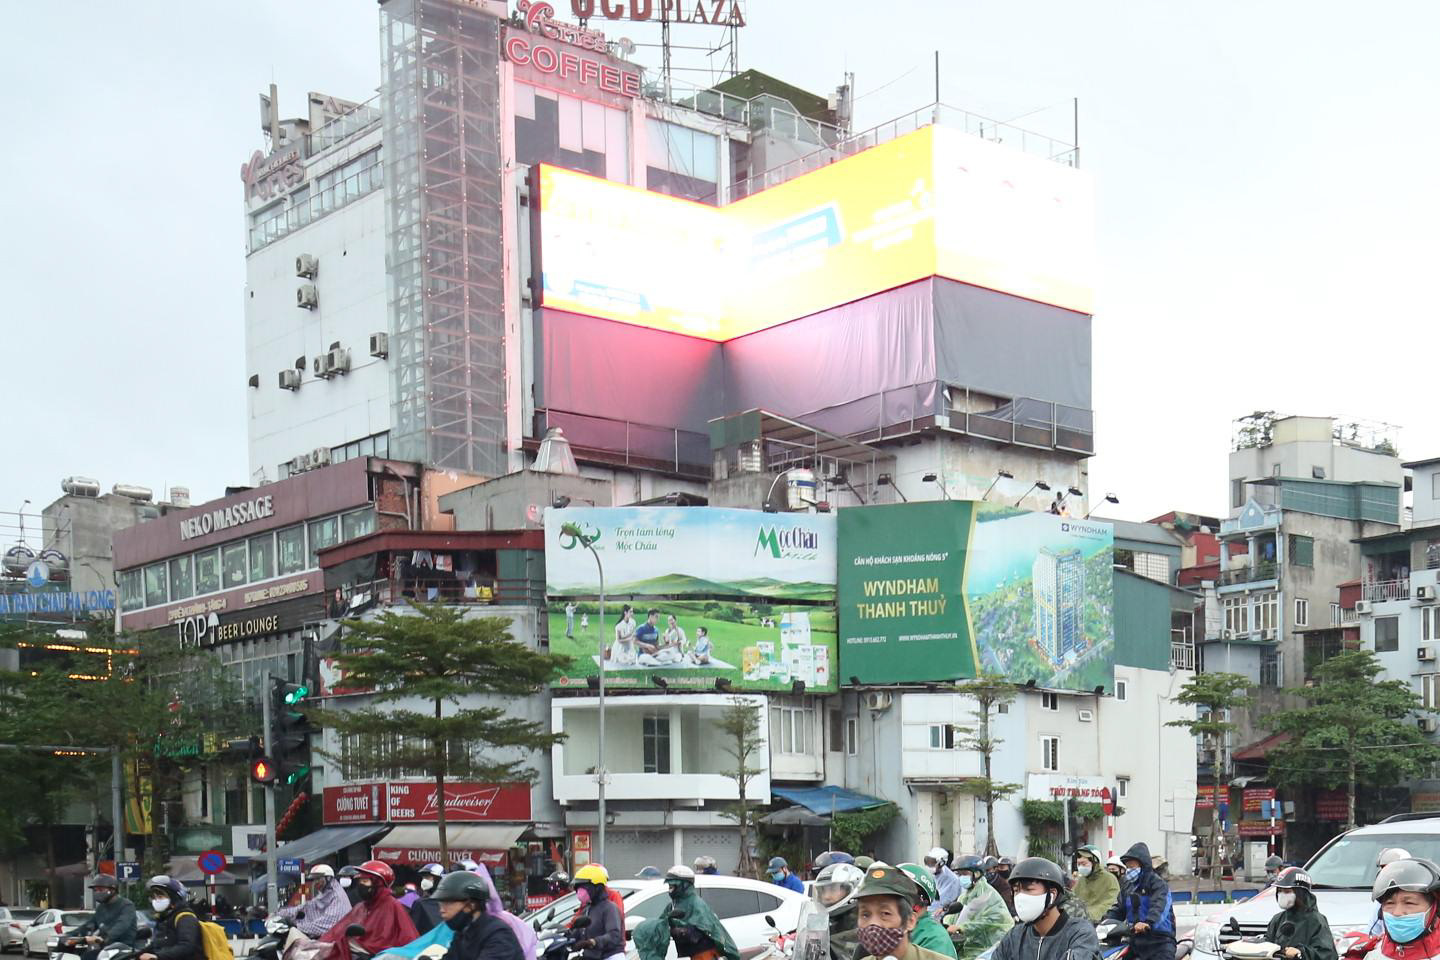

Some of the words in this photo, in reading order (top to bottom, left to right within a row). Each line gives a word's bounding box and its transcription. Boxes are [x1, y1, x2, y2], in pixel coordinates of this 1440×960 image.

[506, 38, 640, 97] COFFEE
[180, 513, 213, 541] NEKO
[213, 495, 275, 531] MASSAGE
[863, 577, 939, 597] WYNDHAM
[857, 601, 906, 619] THANH
[175, 613, 207, 649] TOP
[218, 624, 239, 641] BEER
[240, 615, 279, 638] LOUNGE
[390, 785, 410, 795] KING
[390, 797, 401, 807] OF
[391, 808, 415, 818] BEERS
